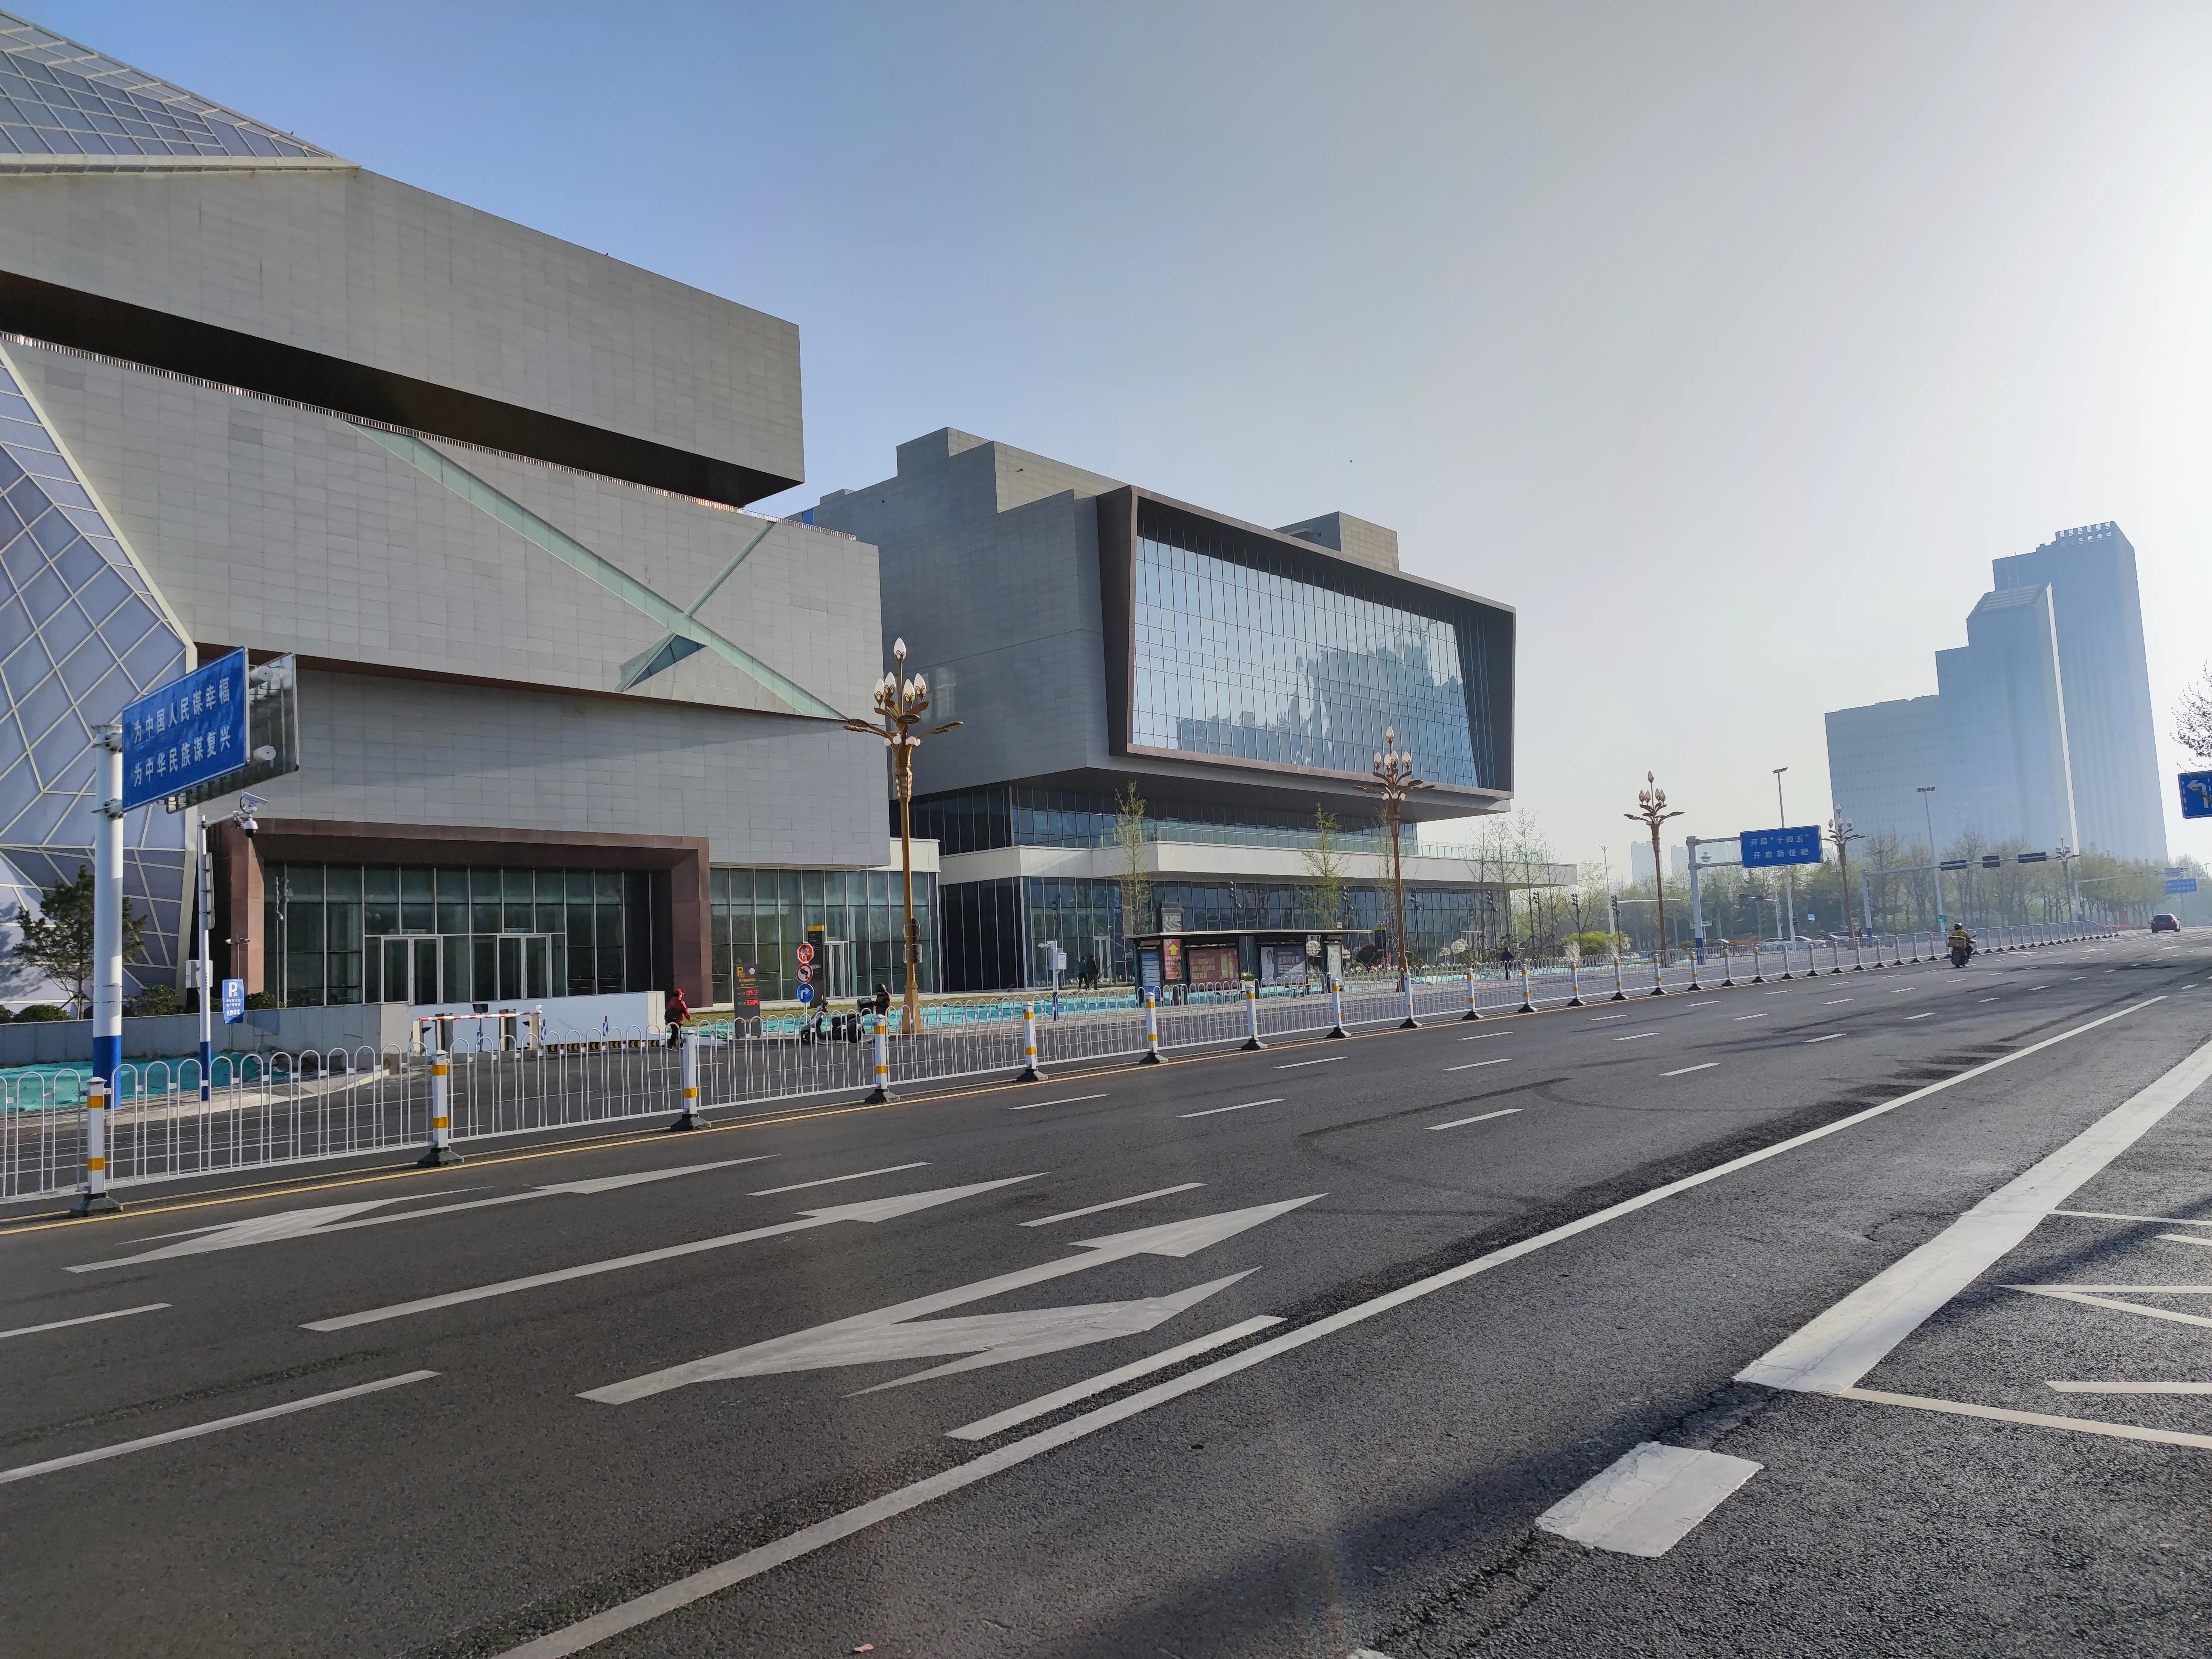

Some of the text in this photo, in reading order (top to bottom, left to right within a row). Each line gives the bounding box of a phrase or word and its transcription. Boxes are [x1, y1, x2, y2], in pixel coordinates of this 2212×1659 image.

[134, 677, 230, 745] 为中国人民谋幸福
[133, 725, 231, 788] 为中华民族谋复兴
[1751, 834, 1809, 846] 开局“十四五”
[1753, 848, 1809, 859] 开启新征程
[737, 966, 744, 977] P
[229, 982, 238, 998] P
